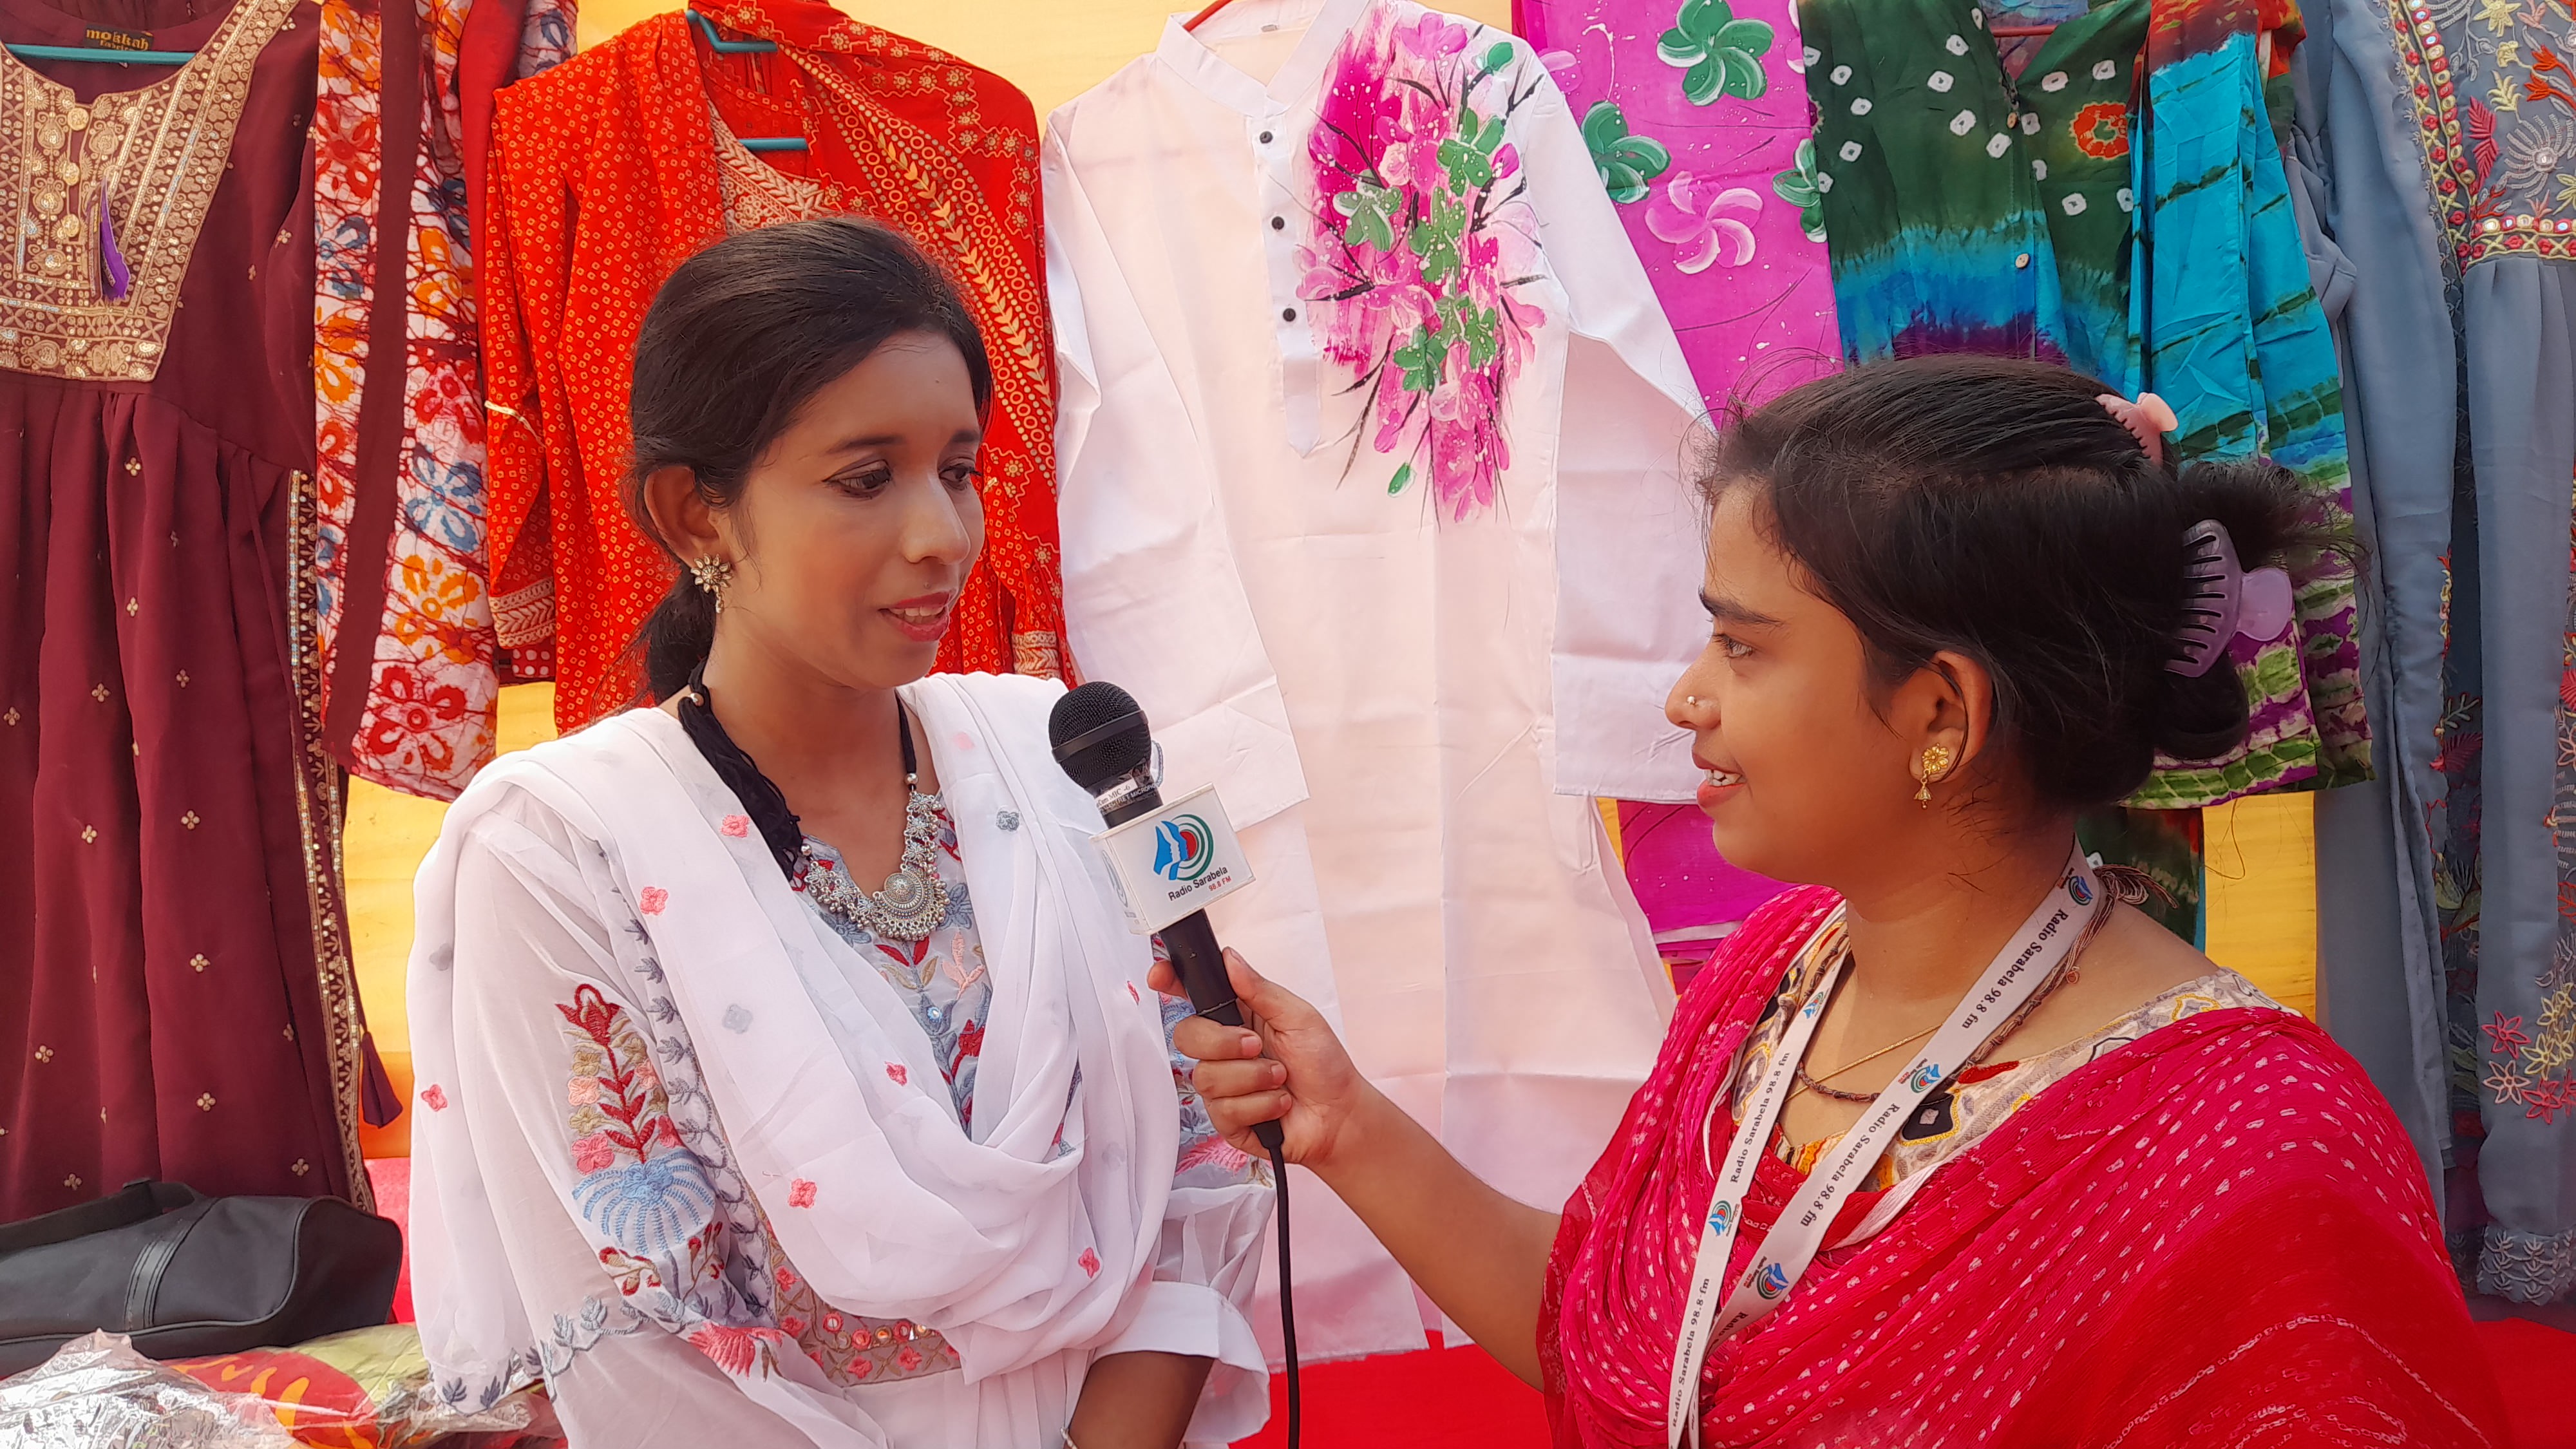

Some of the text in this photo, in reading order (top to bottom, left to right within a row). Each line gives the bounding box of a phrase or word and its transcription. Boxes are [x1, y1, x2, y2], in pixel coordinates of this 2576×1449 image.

[1108, 788, 1123, 799] MIC
[1168, 867, 1227, 901] Radio Sarabela
[1222, 876, 1231, 885] FM
[2039, 909, 2069, 941] Radio
[1998, 942, 2042, 986] Sarabela
[1976, 987, 2001, 1012] 98.8
[1962, 1013, 1978, 1028] fm
[1730, 1052, 1790, 1183] Radio Sarabela 98.8 fm
[1801, 1103, 1900, 1226] Radio Sarabela 98.8 fm
[1678, 1331, 1695, 1385] Sarabela
[1691, 1299, 1703, 1326] 98.8
[1700, 1278, 1710, 1294] fm
